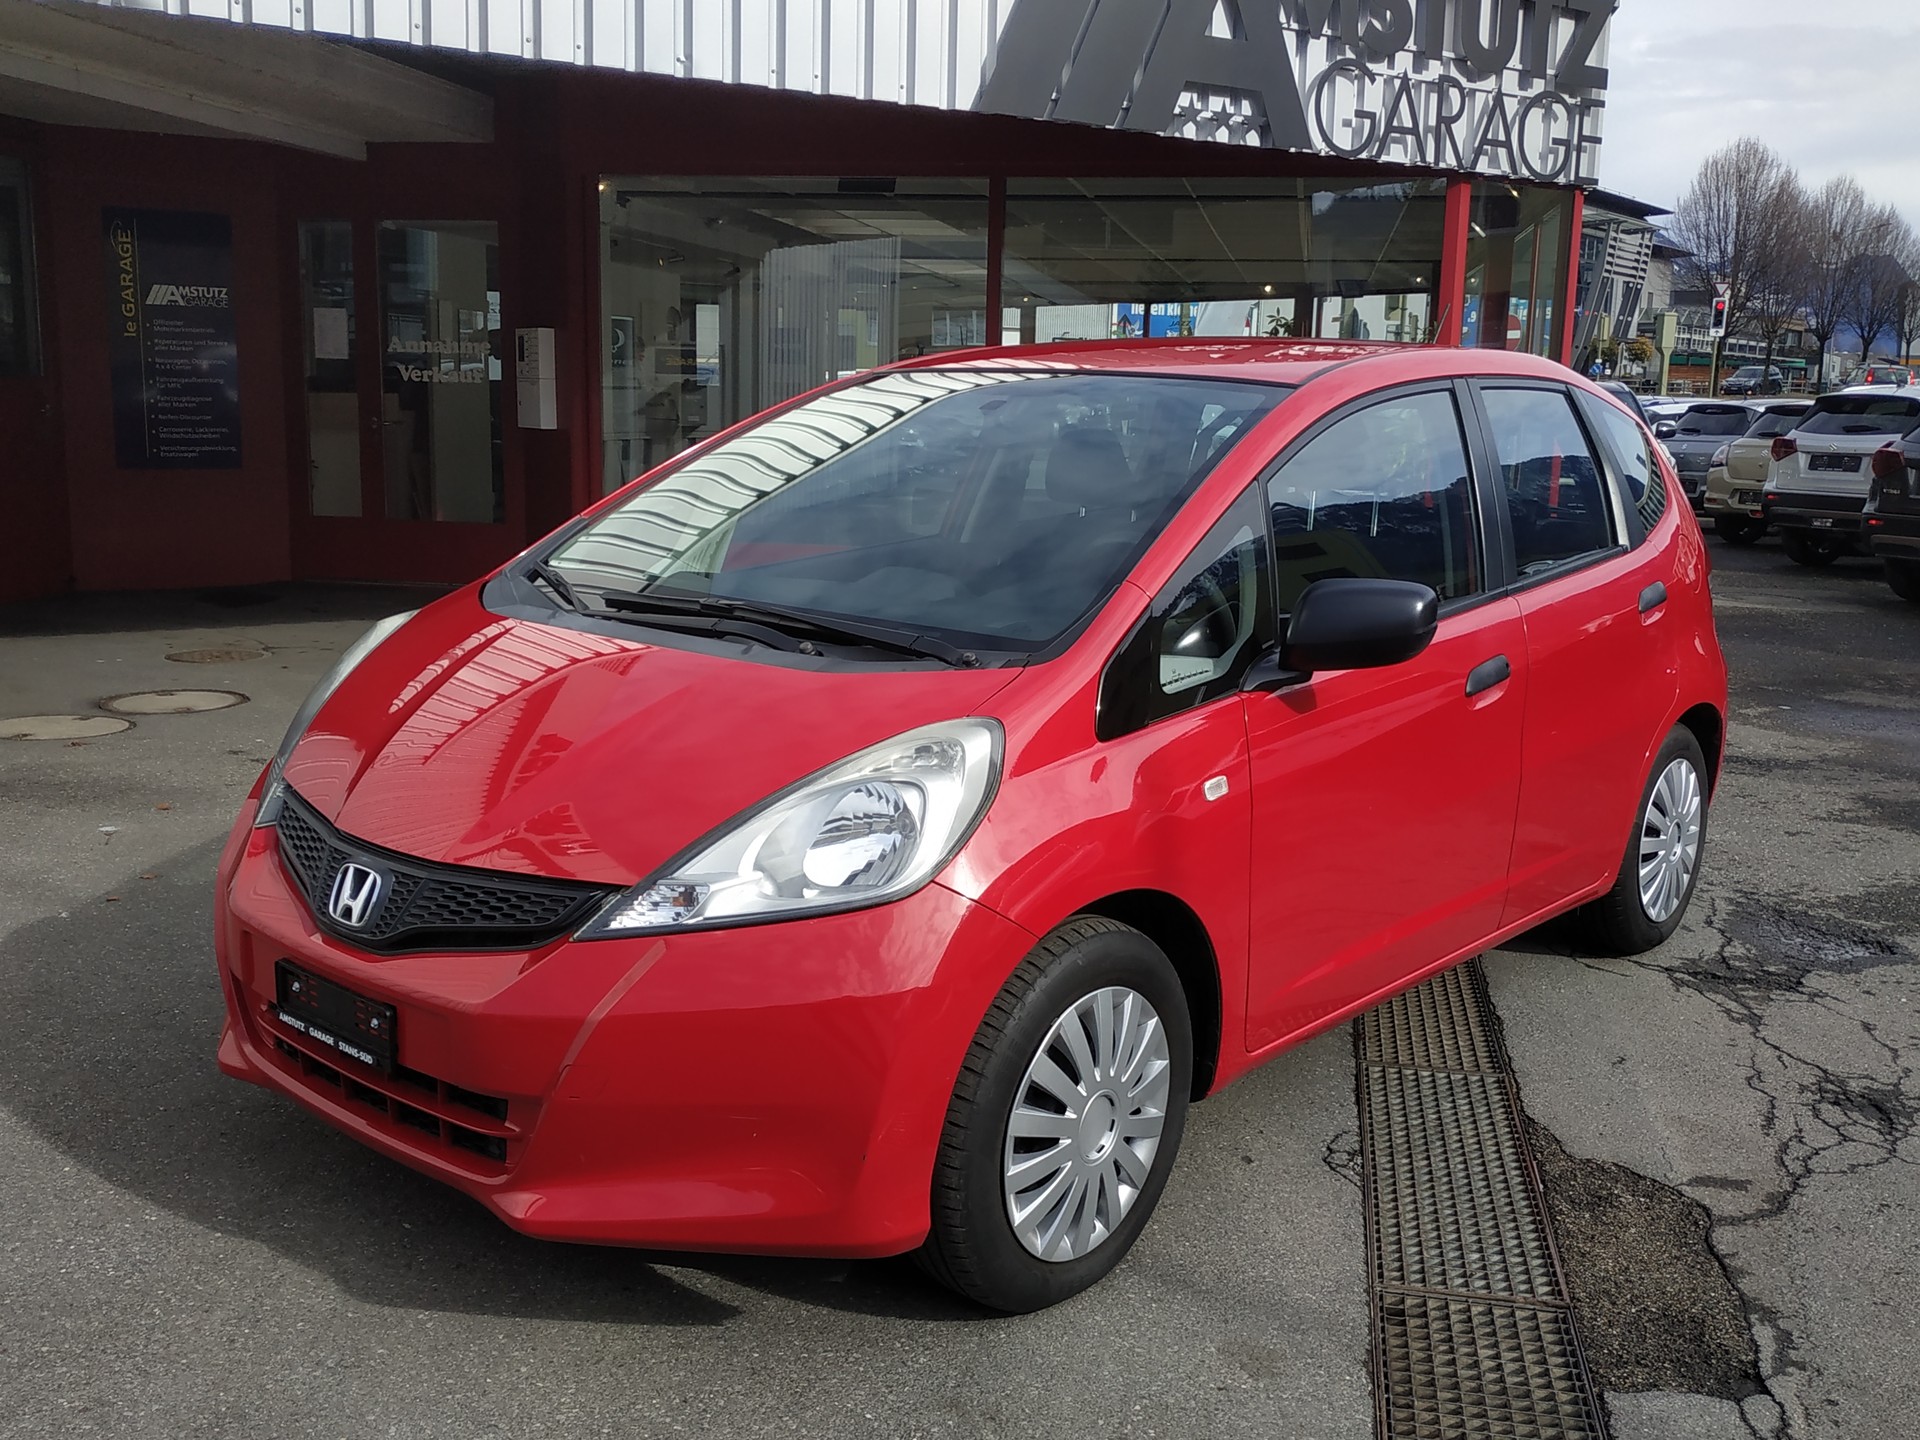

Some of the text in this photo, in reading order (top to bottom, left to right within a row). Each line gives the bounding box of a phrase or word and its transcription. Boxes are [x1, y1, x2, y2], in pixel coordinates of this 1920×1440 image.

[1315, 58, 1606, 186] GARAGE
[118, 229, 137, 337] le GARAGE
[162, 284, 228, 305] AMSTUTZ
[184, 296, 229, 308] GARAGE
[387, 335, 492, 354] Annahme
[396, 364, 485, 384] Verkauf
[279, 1012, 373, 1065] AMSTUTZ GARAGE STANS-SÜD
